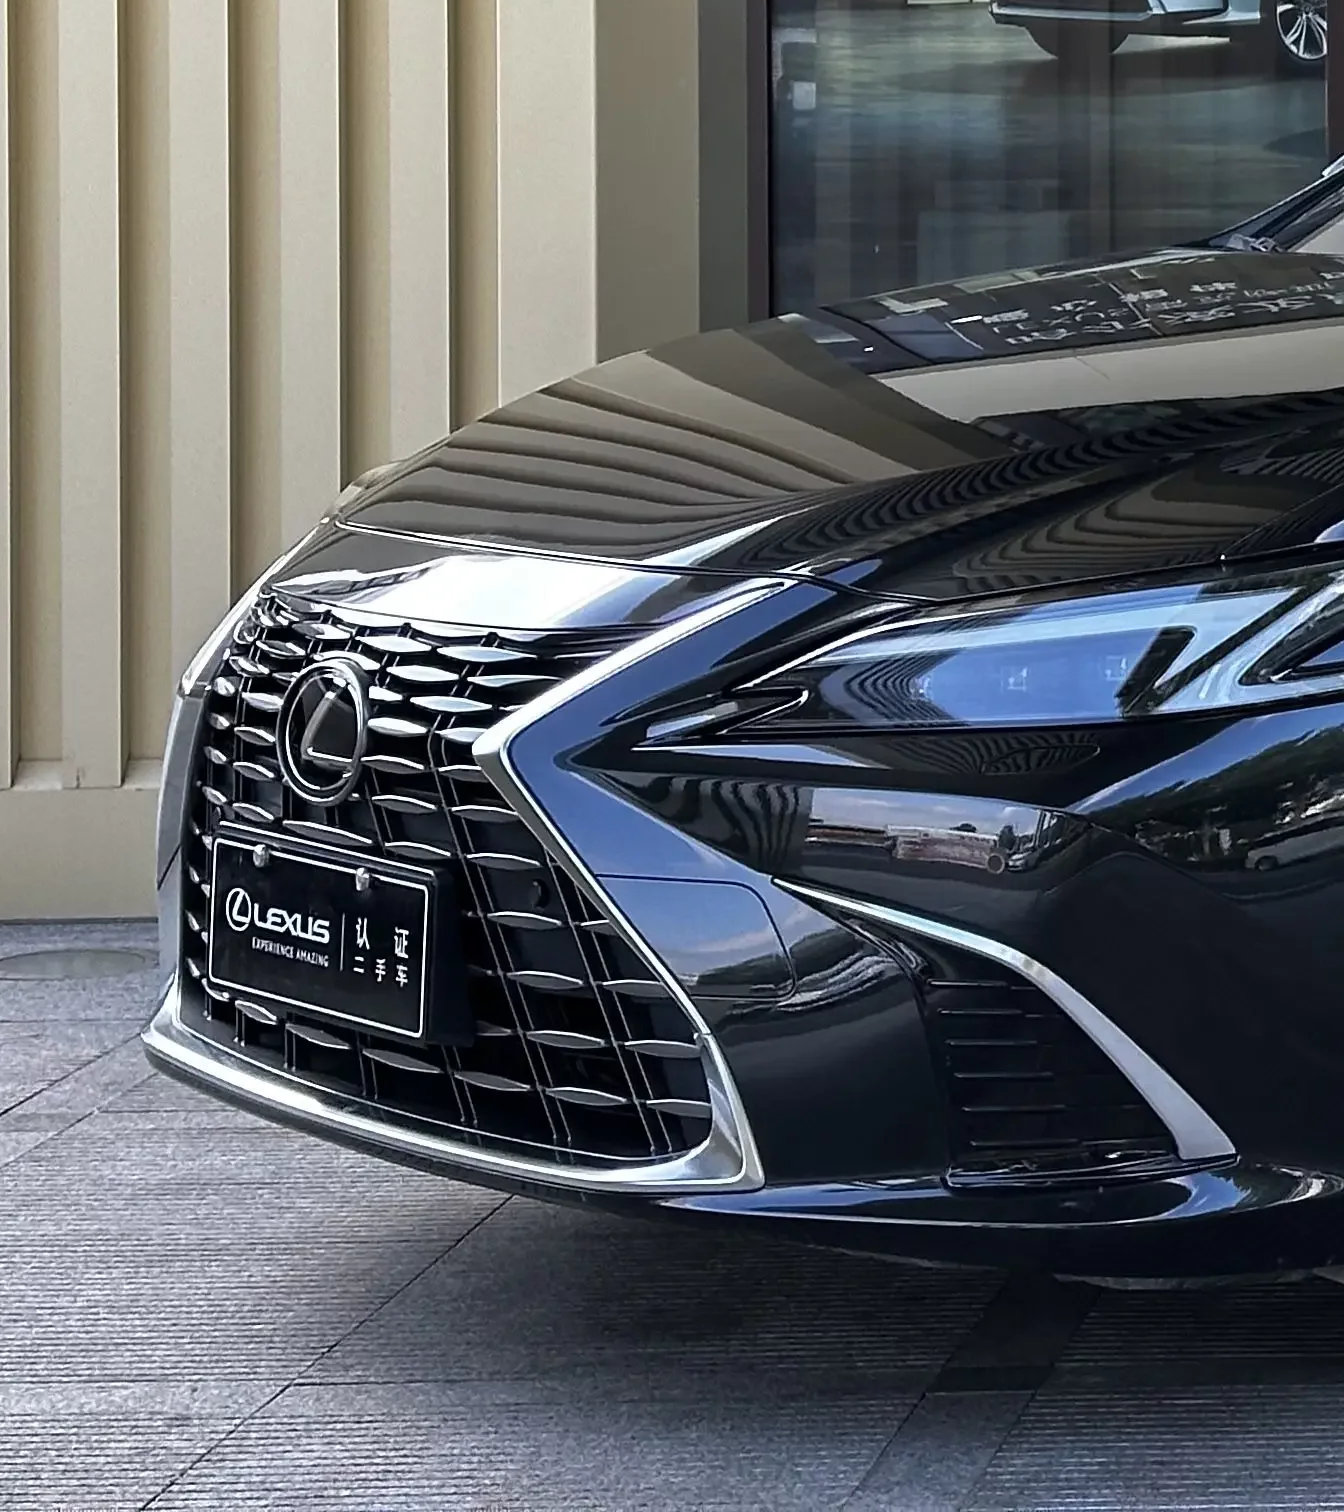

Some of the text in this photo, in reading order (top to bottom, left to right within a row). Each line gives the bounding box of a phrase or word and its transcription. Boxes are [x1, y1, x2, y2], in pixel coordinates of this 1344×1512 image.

[253, 902, 330, 944] LEXUS
[252, 935, 330, 968] EXPERIENCE AMAZING
[353, 955, 409, 988] 二手车
